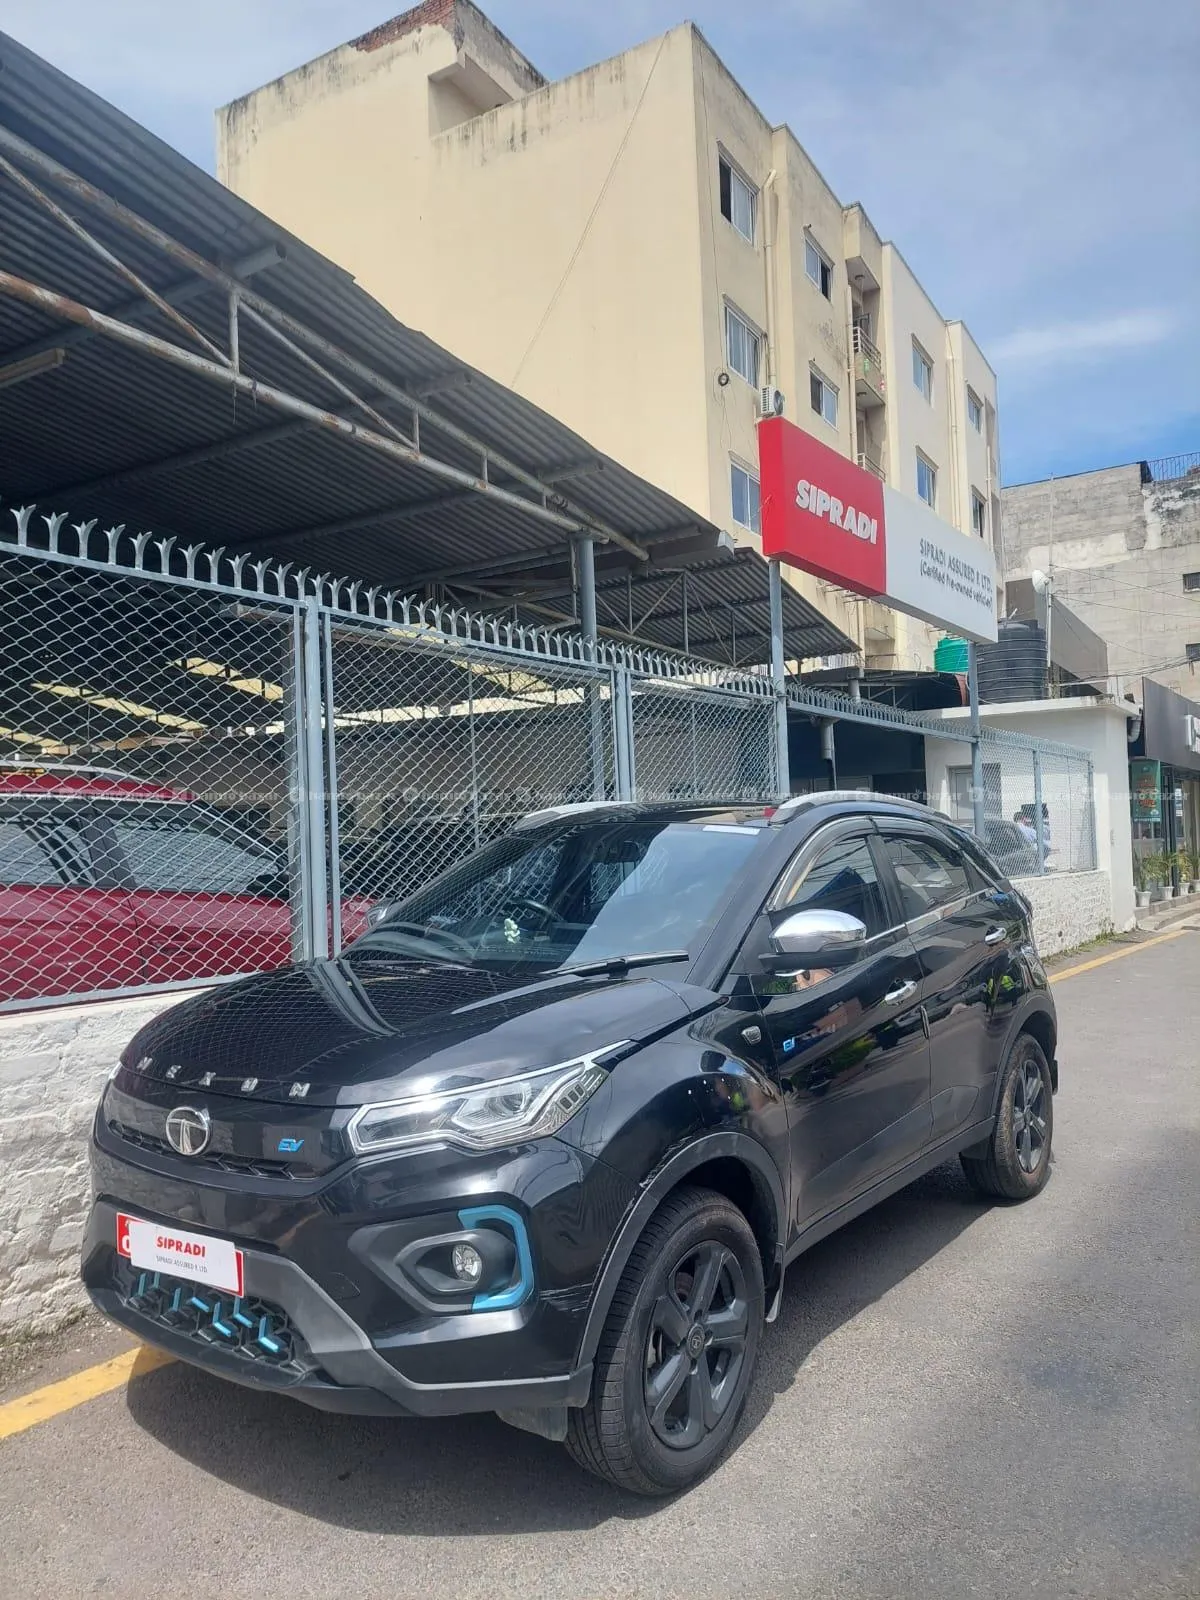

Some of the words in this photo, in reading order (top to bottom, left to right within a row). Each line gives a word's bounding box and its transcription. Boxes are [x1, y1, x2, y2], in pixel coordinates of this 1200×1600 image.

[796, 480, 878, 544] SIPRADI
[920, 538, 946, 566] SIPRADI
[948, 554, 975, 583] ASSURED
[136, 1056, 311, 1098] NEXON
[278, 1138, 304, 1153] EV
[156, 1236, 206, 1257] SIPRADI
